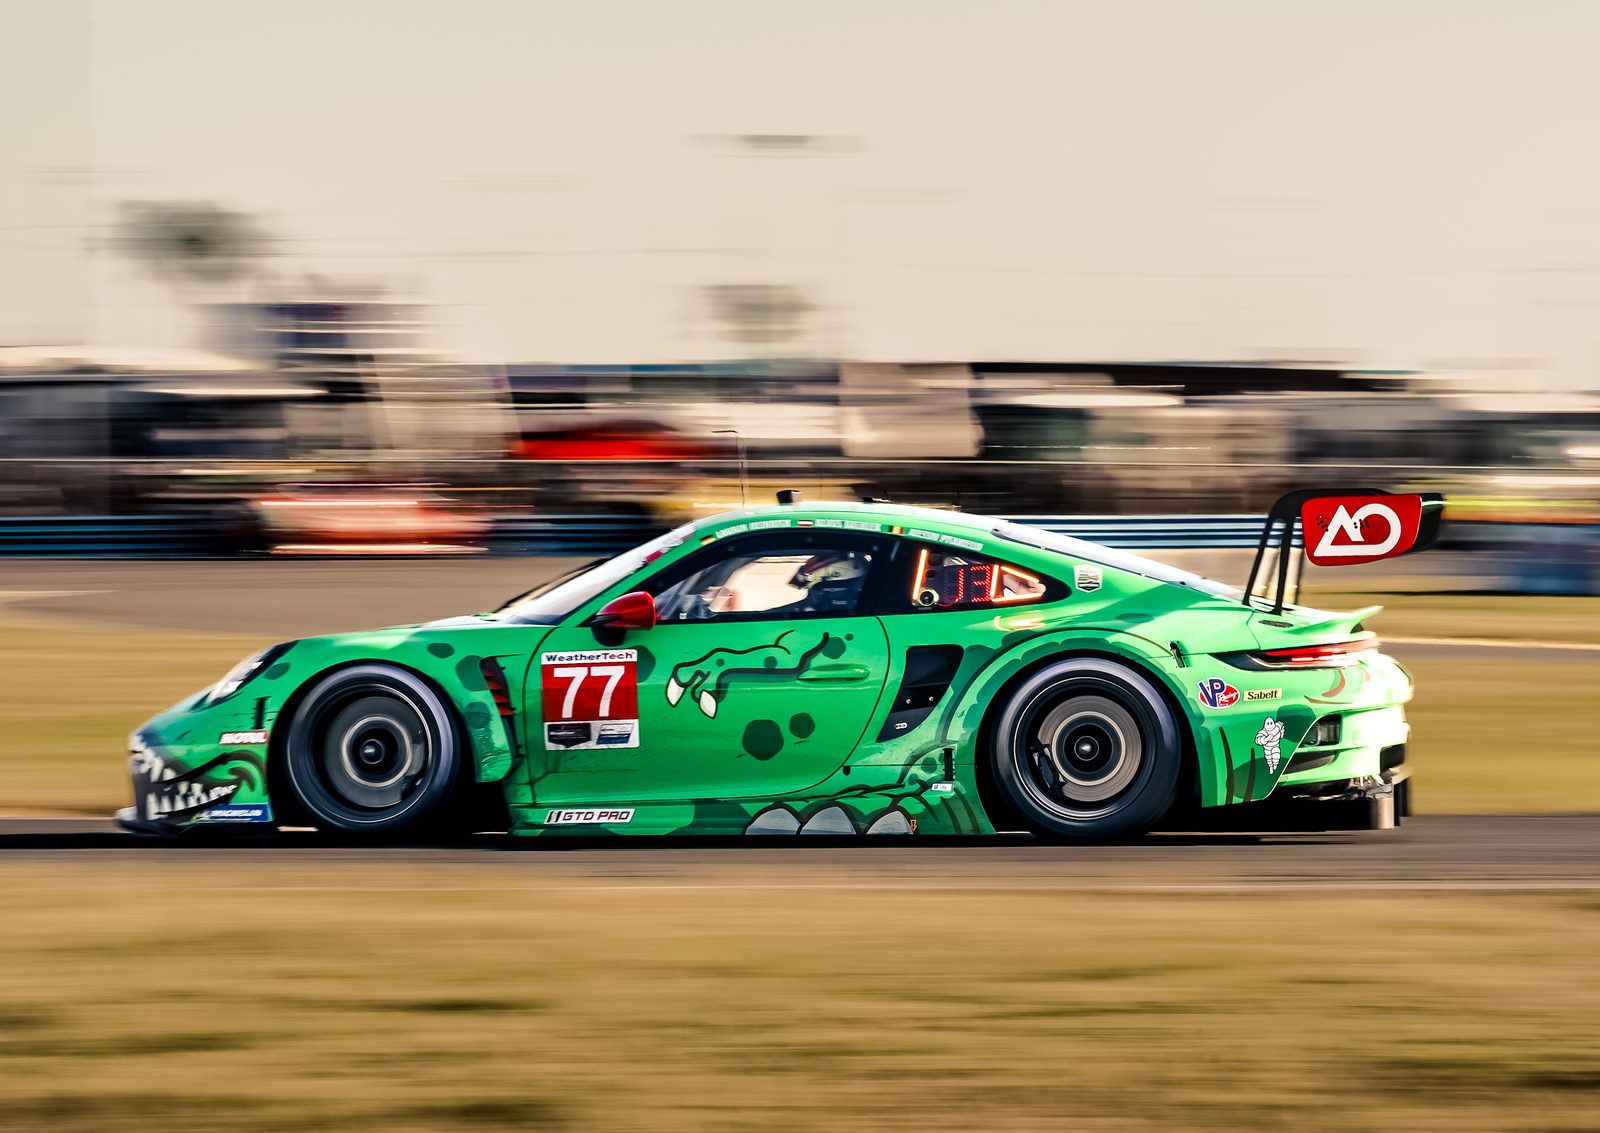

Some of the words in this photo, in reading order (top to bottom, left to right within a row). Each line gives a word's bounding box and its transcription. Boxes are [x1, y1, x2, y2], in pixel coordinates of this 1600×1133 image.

[545, 652, 634, 662] WeatherTech
[554, 666, 625, 718] 77
[1198, 678, 1226, 708] VP
[1247, 690, 1278, 700] Sabelt
[562, 811, 595, 821] GTD
[597, 810, 631, 820] PRO
